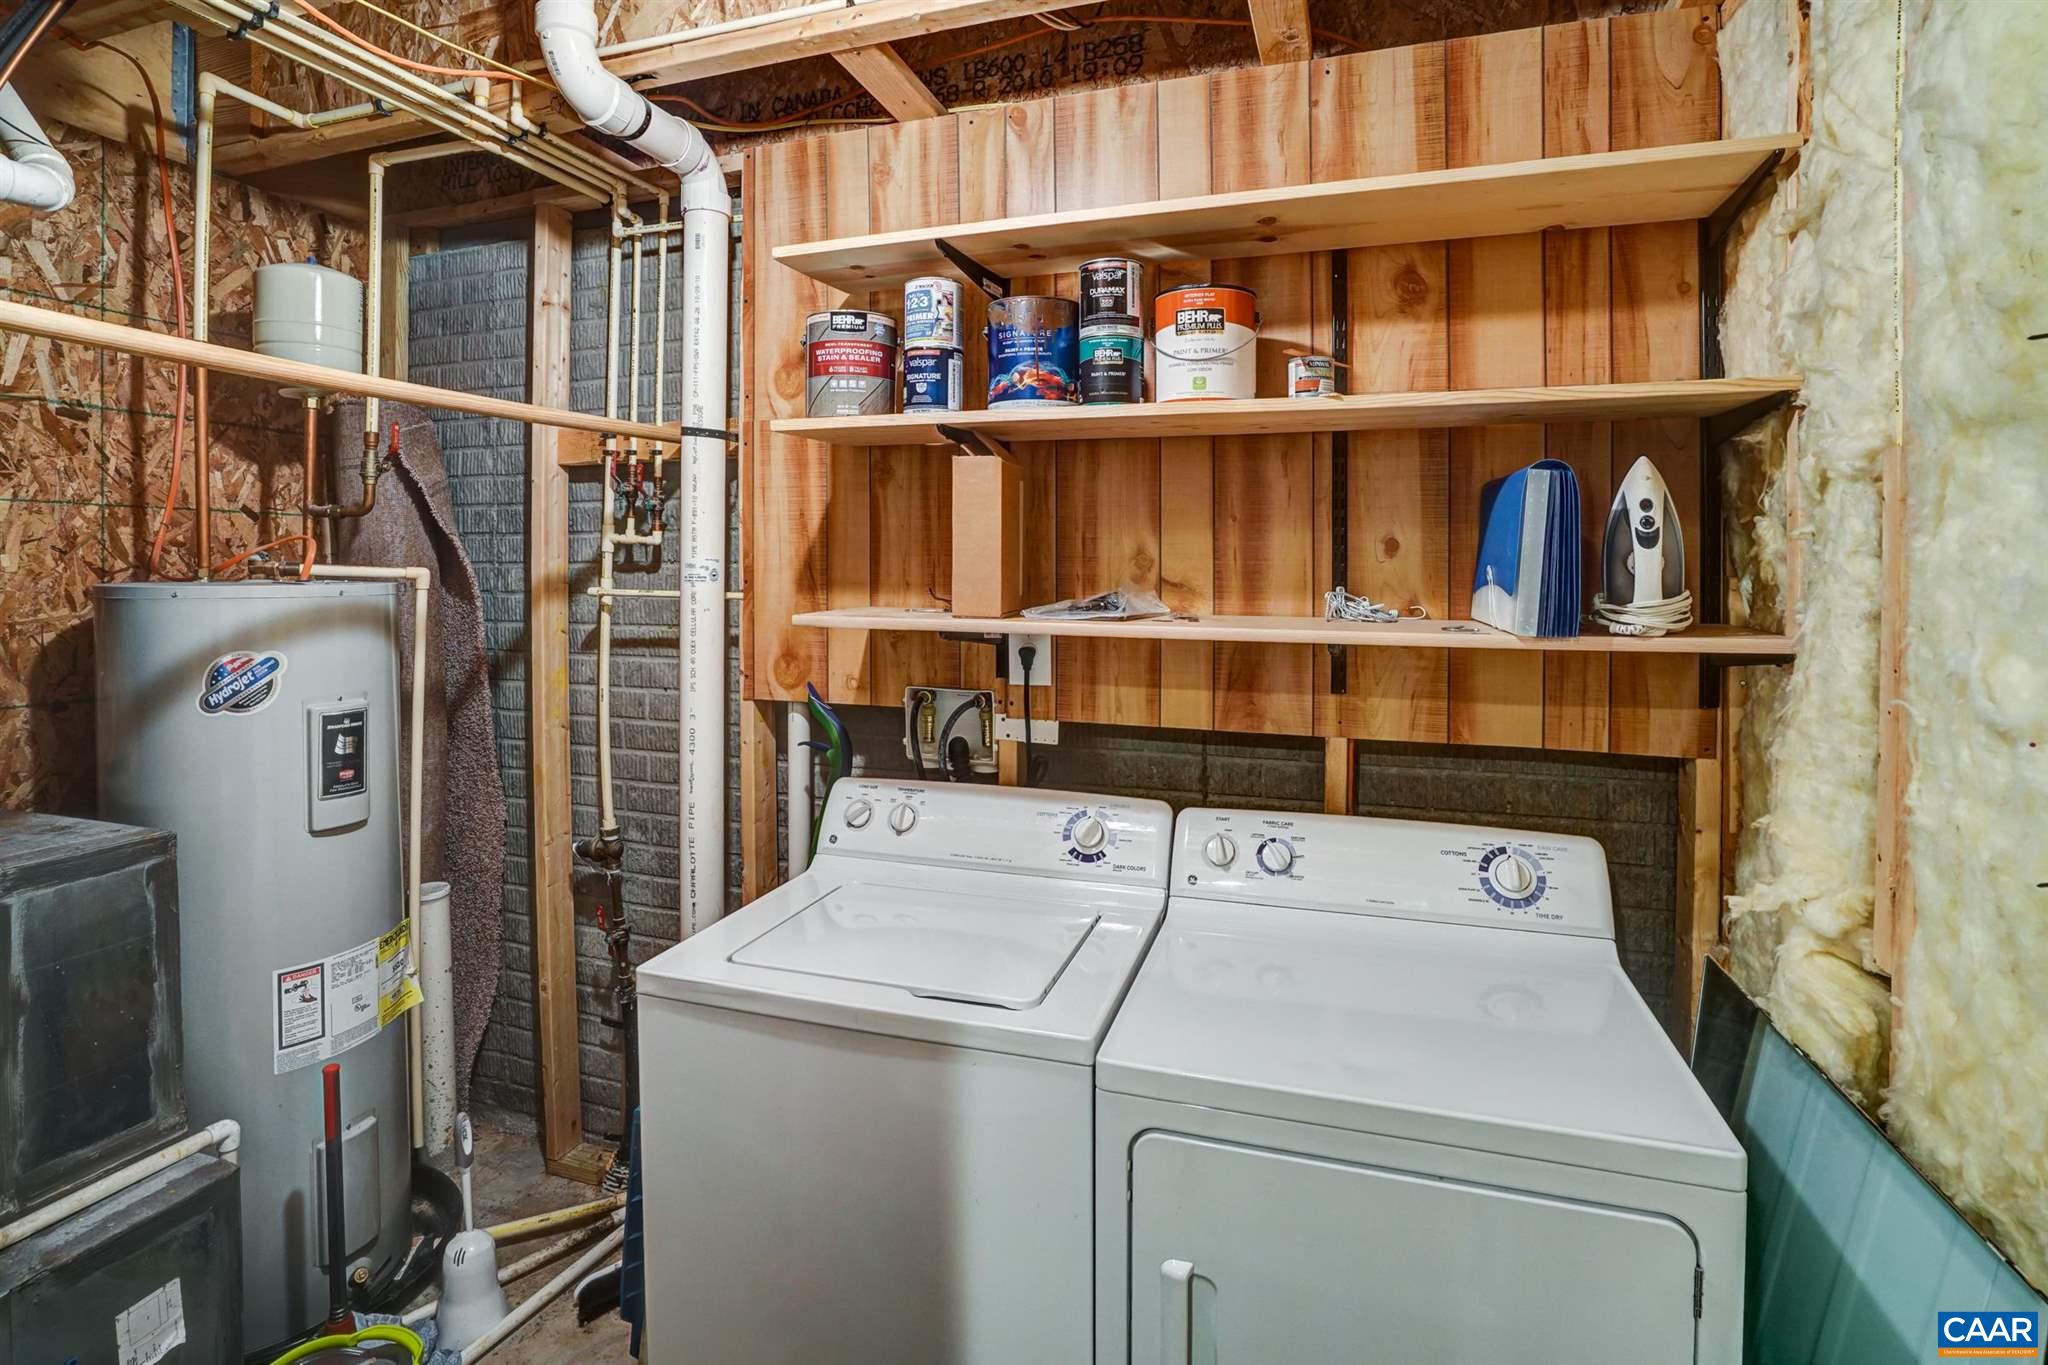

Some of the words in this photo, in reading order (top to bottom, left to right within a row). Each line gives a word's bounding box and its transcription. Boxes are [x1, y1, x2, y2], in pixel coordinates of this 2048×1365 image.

[772, 86, 842, 118] CANADA
[1092, 270, 1122, 281] valspar
[1089, 287, 1126, 296] DURAMAX
[832, 315, 854, 325] BEHR
[1177, 310, 1209, 324] BEHR
[1177, 322, 1205, 331] PREMIUM
[1206, 321, 1223, 329] PLUS
[815, 347, 883, 357] WATERPROOFING
[1094, 349, 1113, 358] BEHR
[817, 354, 839, 362] STAIN
[848, 354, 881, 363] SEALER
[909, 357, 937, 369] valspar
[906, 372, 941, 381] SIGNATURE
[208, 671, 255, 706] Hydrojet
[688, 728, 696, 756] 4300
[688, 837, 696, 899] CHARLOTTE
[1535, 912, 1550, 920] TIME
